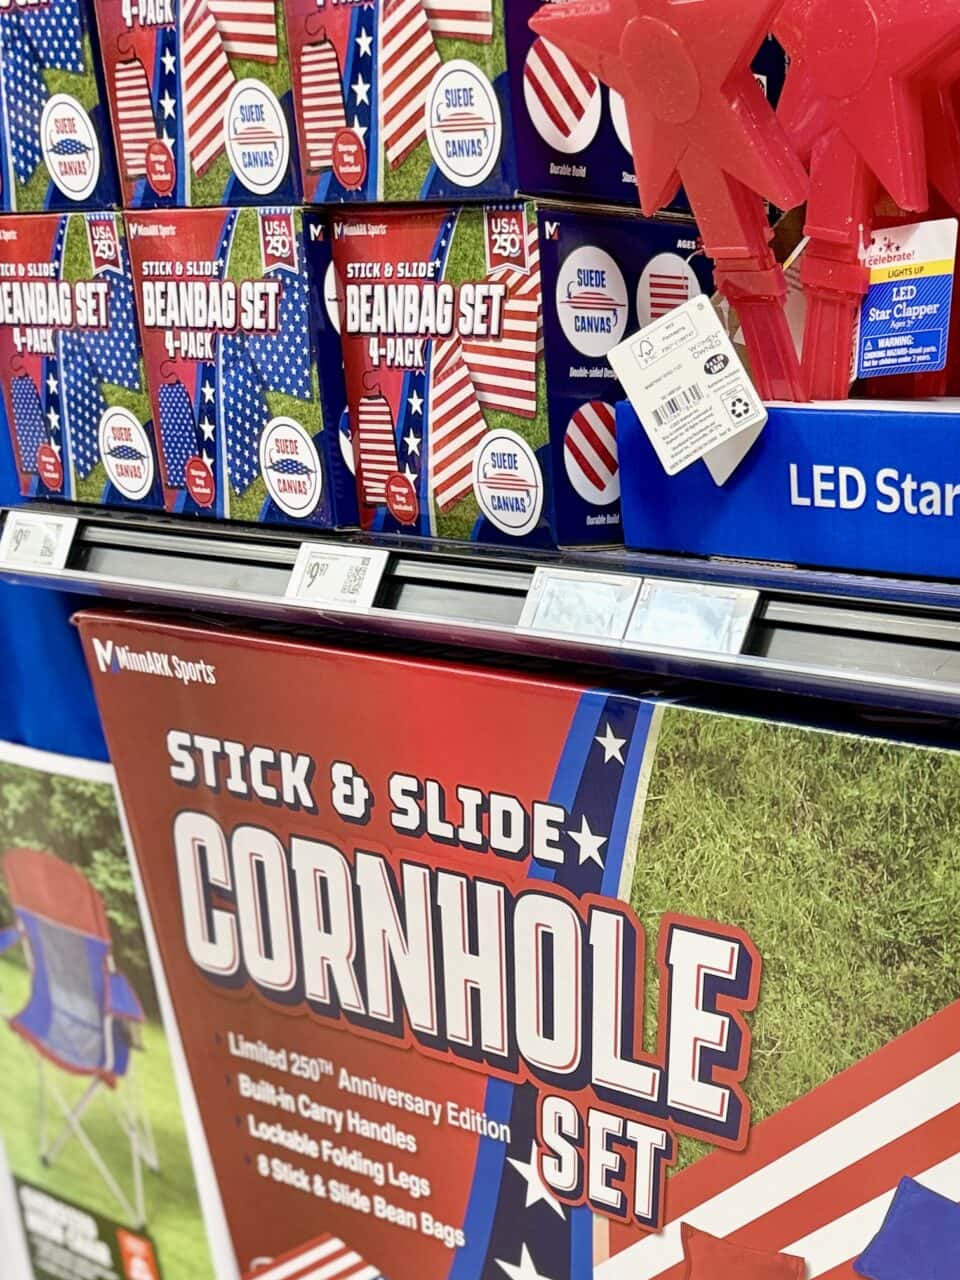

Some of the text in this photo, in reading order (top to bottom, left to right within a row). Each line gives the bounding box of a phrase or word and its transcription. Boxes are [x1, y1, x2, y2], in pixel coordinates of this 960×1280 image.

[444, 88, 475, 108] SUEDE
[240, 105, 265, 122] SUEDE
[54, 117, 77, 134] SUEDE
[445, 140, 483, 159] CANVAS
[58, 160, 87, 177] CANVAS
[242, 151, 275, 169] CANVAS
[92, 226, 114, 240] USA
[265, 221, 288, 235] USA
[491, 218, 520, 234] USA
[492, 234, 520, 257] 250
[676, 239, 696, 250] AGES
[868, 251, 915, 266] celebrate!
[27, 263, 56, 276] SLIDE
[142, 261, 219, 276] STICK & SLIDE
[347, 262, 435, 278] STICK & SLIDE
[576, 268, 606, 288] SUEDE
[888, 266, 924, 278] LIGHTS UP
[892, 286, 916, 301] LED
[0, 282, 108, 328] EANBAG SET
[142, 281, 279, 330] BEANBAG SET
[346, 284, 505, 336] BEANBAG SET
[869, 302, 939, 321] Star Clapper
[574, 314, 612, 334] CANVAS
[13, 329, 56, 354] 4-PACK
[164, 331, 214, 360] 4-PACK
[368, 338, 426, 368] 4-PACK
[111, 427, 133, 442] SUEDE
[275, 438, 299, 455] SUEDE
[490, 452, 519, 470] SUEDE
[115, 464, 142, 479] CANVAS
[277, 477, 308, 496] CANVAS
[789, 463, 866, 510] LED
[490, 494, 527, 513] CANVAS
[117, 645, 216, 685] MinnARK Sports
[166, 729, 566, 864] STICK & SLIDE
[172, 810, 741, 1124] CORNHOLE
[228, 1031, 287, 1071] Limited
[338, 1068, 443, 1125] Anniversary
[447, 1103, 512, 1144] Edition
[238, 1074, 417, 1153] Built-in Carry Handles
[247, 1114, 431, 1199] Lockable Folding Legs
[538, 1096, 667, 1220] SET
[257, 1154, 465, 1250] 8 Stick & Slide Bean Bags
